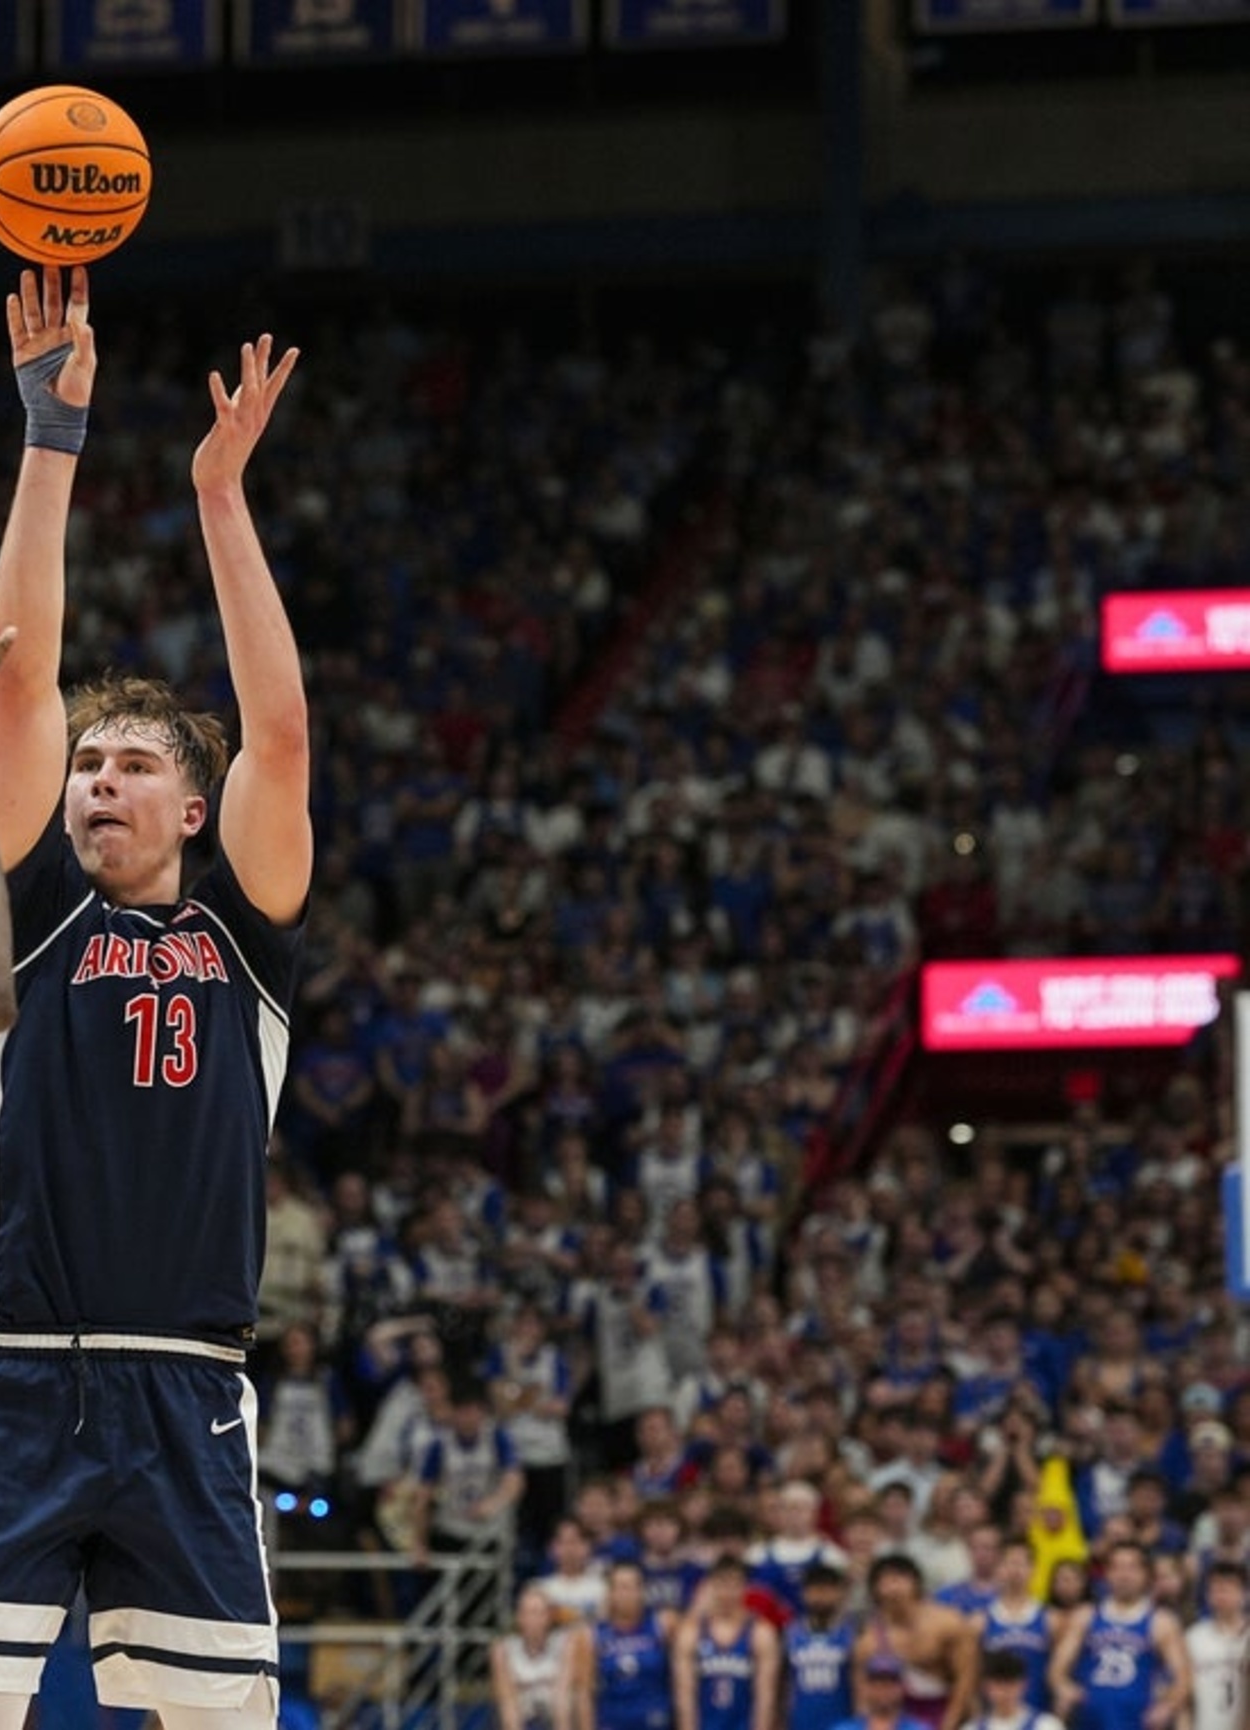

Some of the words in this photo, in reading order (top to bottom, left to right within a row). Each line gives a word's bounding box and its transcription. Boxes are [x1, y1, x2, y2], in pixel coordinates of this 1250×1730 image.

[30, 163, 141, 195] Wilson
[41, 223, 124, 247] NCAA
[70, 930, 231, 986] ARIONA
[123, 993, 199, 1088] 13
